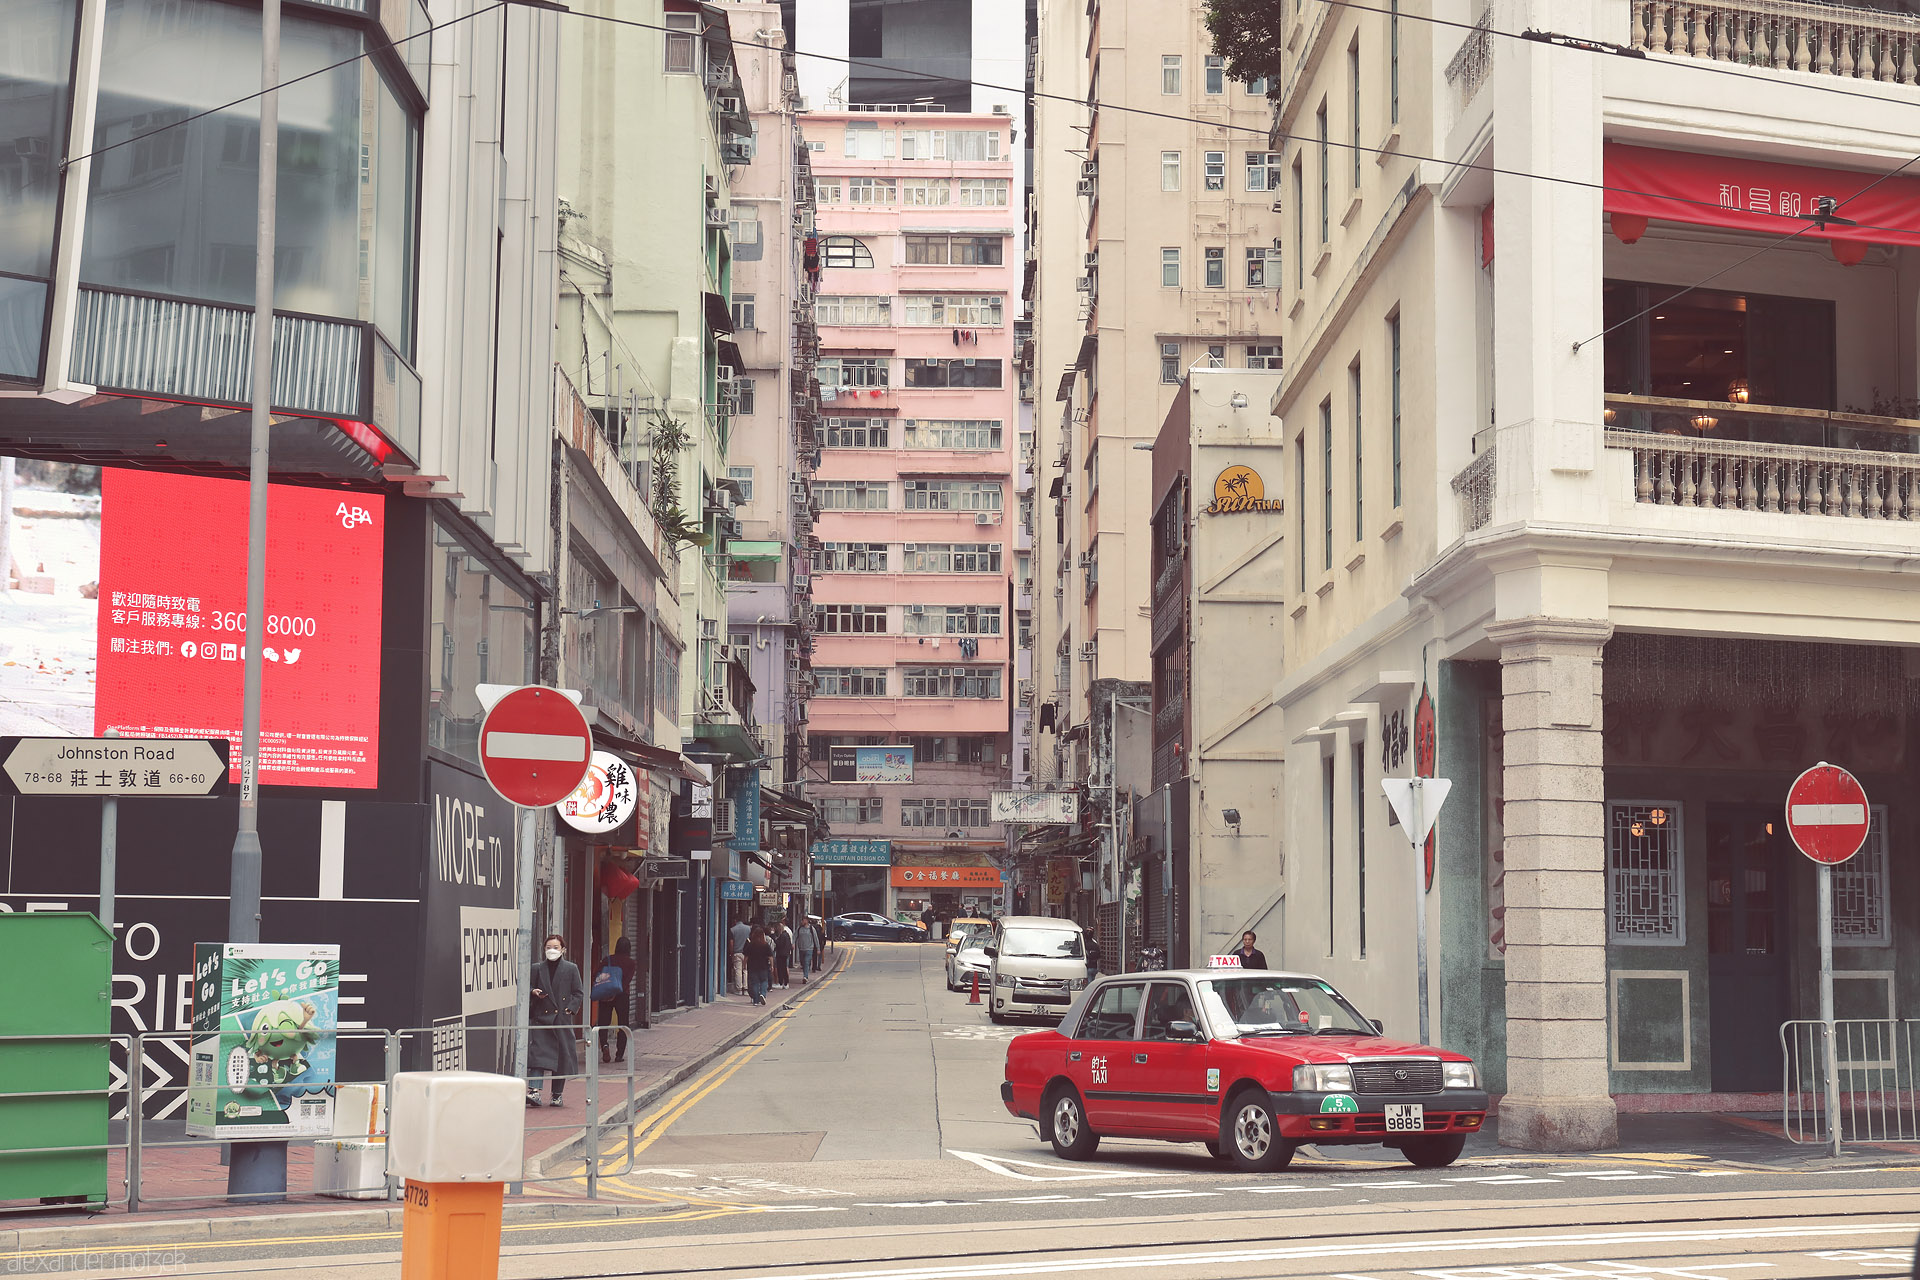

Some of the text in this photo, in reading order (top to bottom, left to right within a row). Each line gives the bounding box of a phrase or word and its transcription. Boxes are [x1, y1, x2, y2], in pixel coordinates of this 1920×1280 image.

[111, 591, 200, 612] 歡迎隨時致電
[210, 610, 248, 632] 360
[266, 615, 316, 637] 8000
[57, 745, 175, 760] Johnston Road
[70, 769, 161, 788] 莊士敦道
[435, 793, 502, 888] MORE TO
[197, 951, 219, 981] Let's
[464, 928, 519, 993] EXPERIENC
[1216, 956, 1240, 966] TAXI
[232, 960, 328, 998] Let's Go
[201, 981, 215, 1002] Go
[231, 990, 271, 1009] 支持社企
[1091, 1056, 1107, 1070] 的士
[1091, 1069, 1107, 1084] TAXI
[1335, 1099, 1343, 1107] 5
[1396, 1105, 1412, 1117] JW
[1388, 1117, 1421, 1130] 9885
[404, 1185, 429, 1208] 47728
